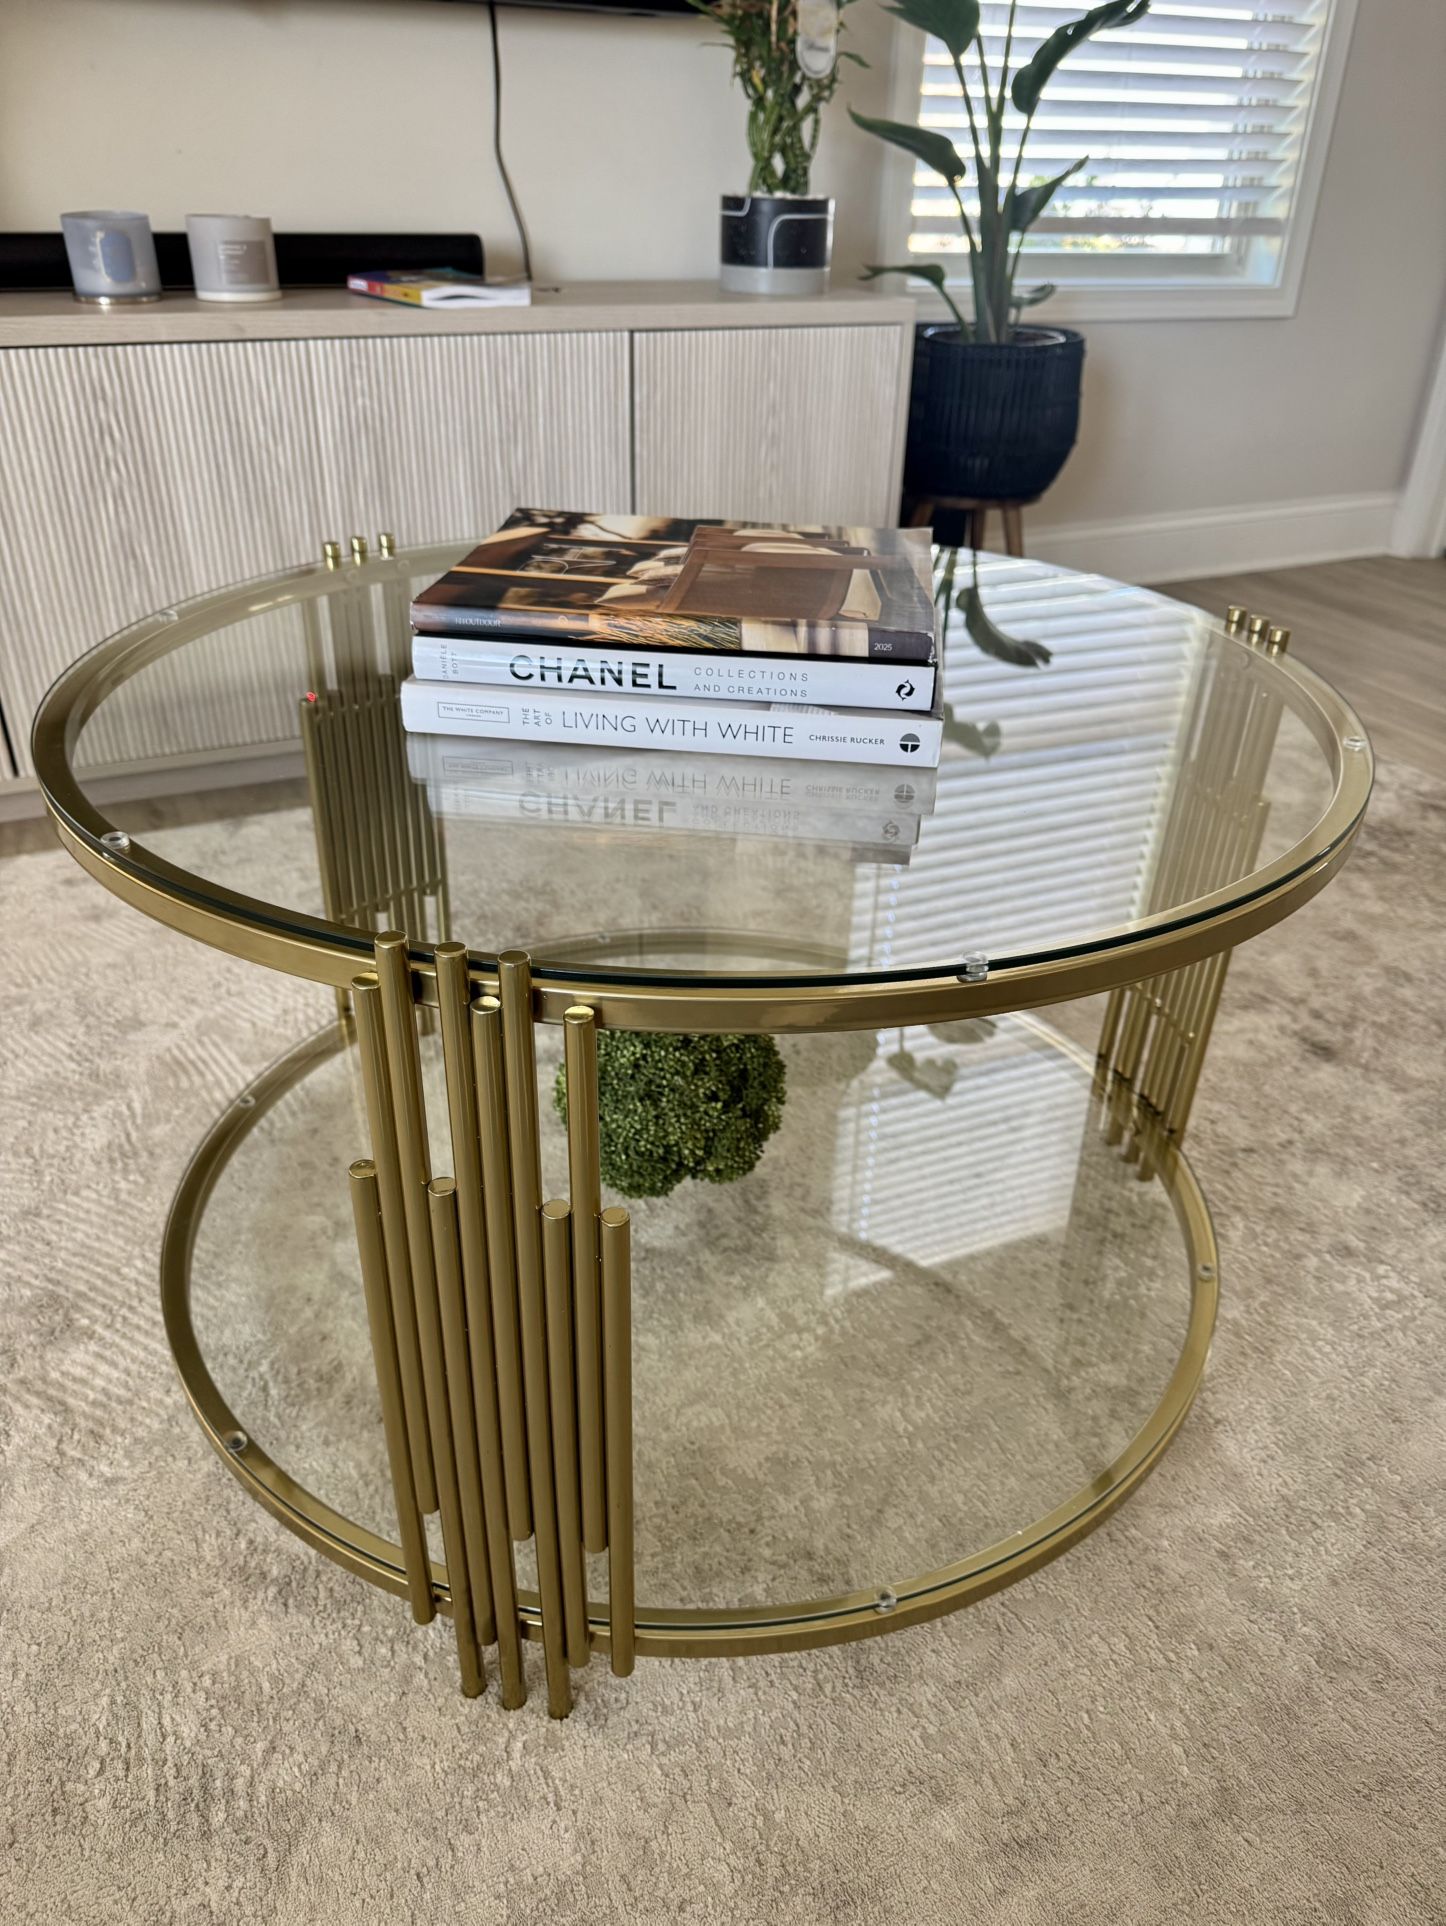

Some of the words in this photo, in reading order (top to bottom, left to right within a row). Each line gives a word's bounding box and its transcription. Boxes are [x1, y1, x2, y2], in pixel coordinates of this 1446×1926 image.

[874, 642, 893, 652] 2025
[451, 652, 459, 675] BOTT
[509, 654, 678, 691] CHANEL
[694, 666, 809, 682] COLLECTIONS
[693, 684, 722, 694] AND
[727, 685, 808, 698] CREATIONS
[475, 708, 504, 716] COMPANY
[521, 708, 530, 726] THE
[545, 712, 553, 725] OF
[562, 710, 637, 733] LIVING
[645, 717, 708, 739] WITH
[717, 721, 795, 744] WHITE
[809, 734, 848, 744] CHRISSIE
[850, 737, 885, 745] RUCKER
